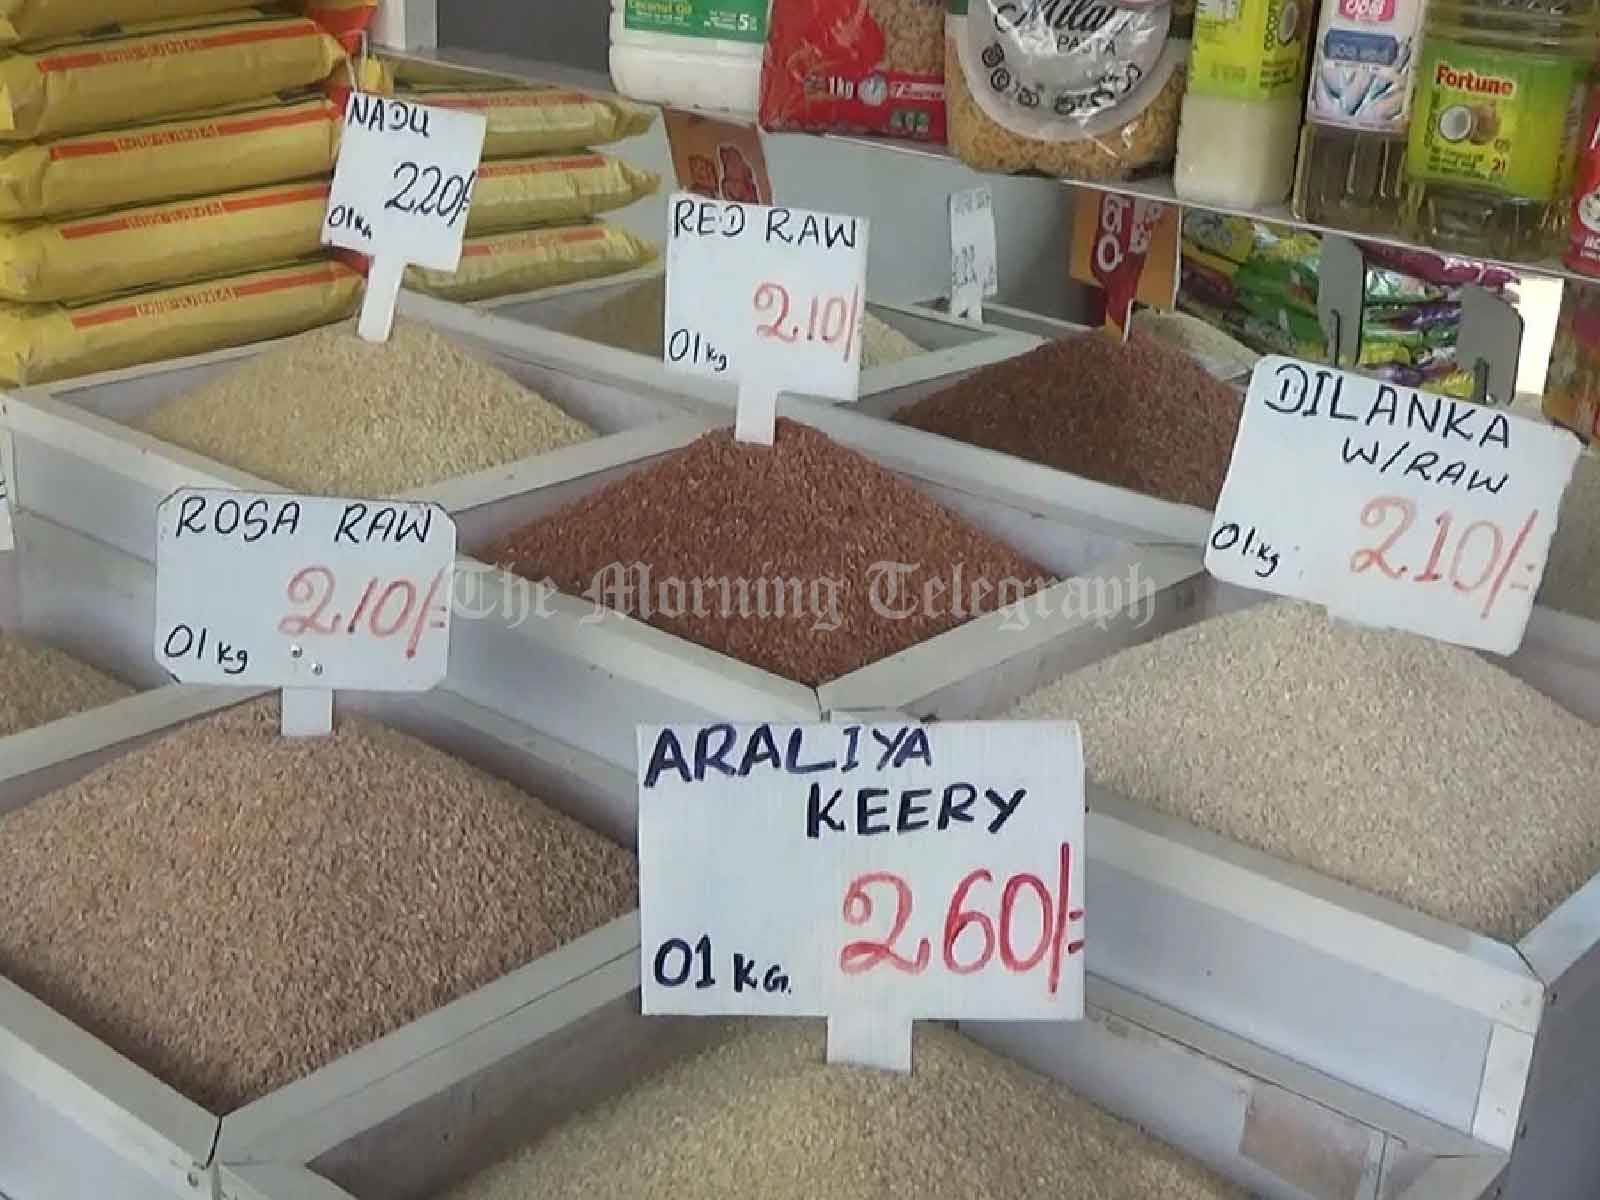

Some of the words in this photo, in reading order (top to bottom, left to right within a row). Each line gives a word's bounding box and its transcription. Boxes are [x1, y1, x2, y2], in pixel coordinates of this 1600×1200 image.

[1435, 64, 1514, 97] Fortune
[348, 96, 430, 138] NADU
[674, 199, 746, 238] RED
[765, 207, 856, 249] RAW
[1263, 363, 1511, 449] DILANKA
[1341, 437, 1509, 494] W/RAW
[176, 496, 301, 543] ROSA
[334, 504, 433, 543] RAW
[643, 723, 932, 788] ARALIYA
[805, 782, 1027, 839] KEERY
